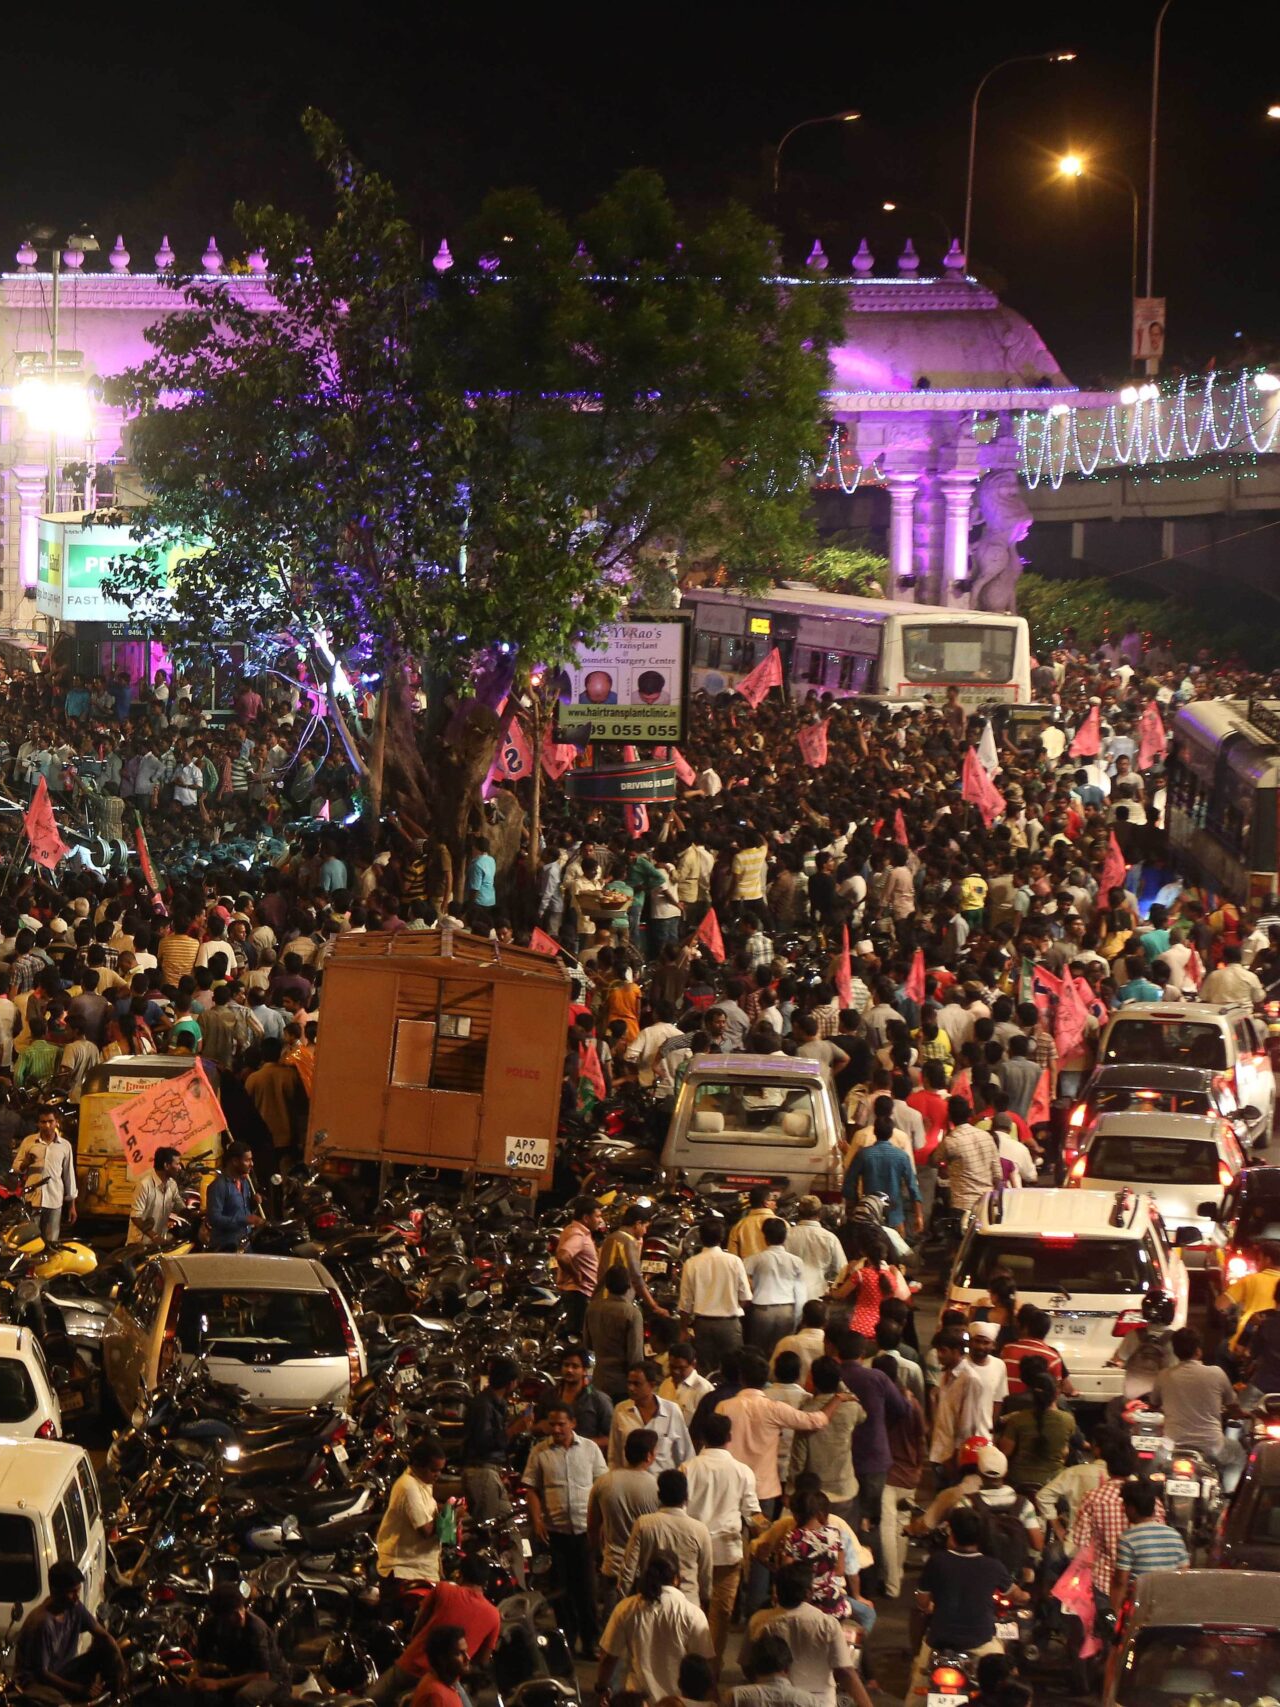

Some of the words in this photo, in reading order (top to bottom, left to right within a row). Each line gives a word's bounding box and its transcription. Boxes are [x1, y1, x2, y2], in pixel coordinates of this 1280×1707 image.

[68, 595, 98, 605] FAST
[615, 641, 658, 652] Transplant
[580, 656, 613, 664] osmetic
[616, 657, 647, 666] Surgery
[649, 656, 676, 664] Centre
[612, 724, 641, 736] 055
[648, 724, 677, 736] 055
[621, 781, 653, 791] DRIVING
[505, 1067, 540, 1081] POLICE
[514, 1139, 536, 1150] AP9
